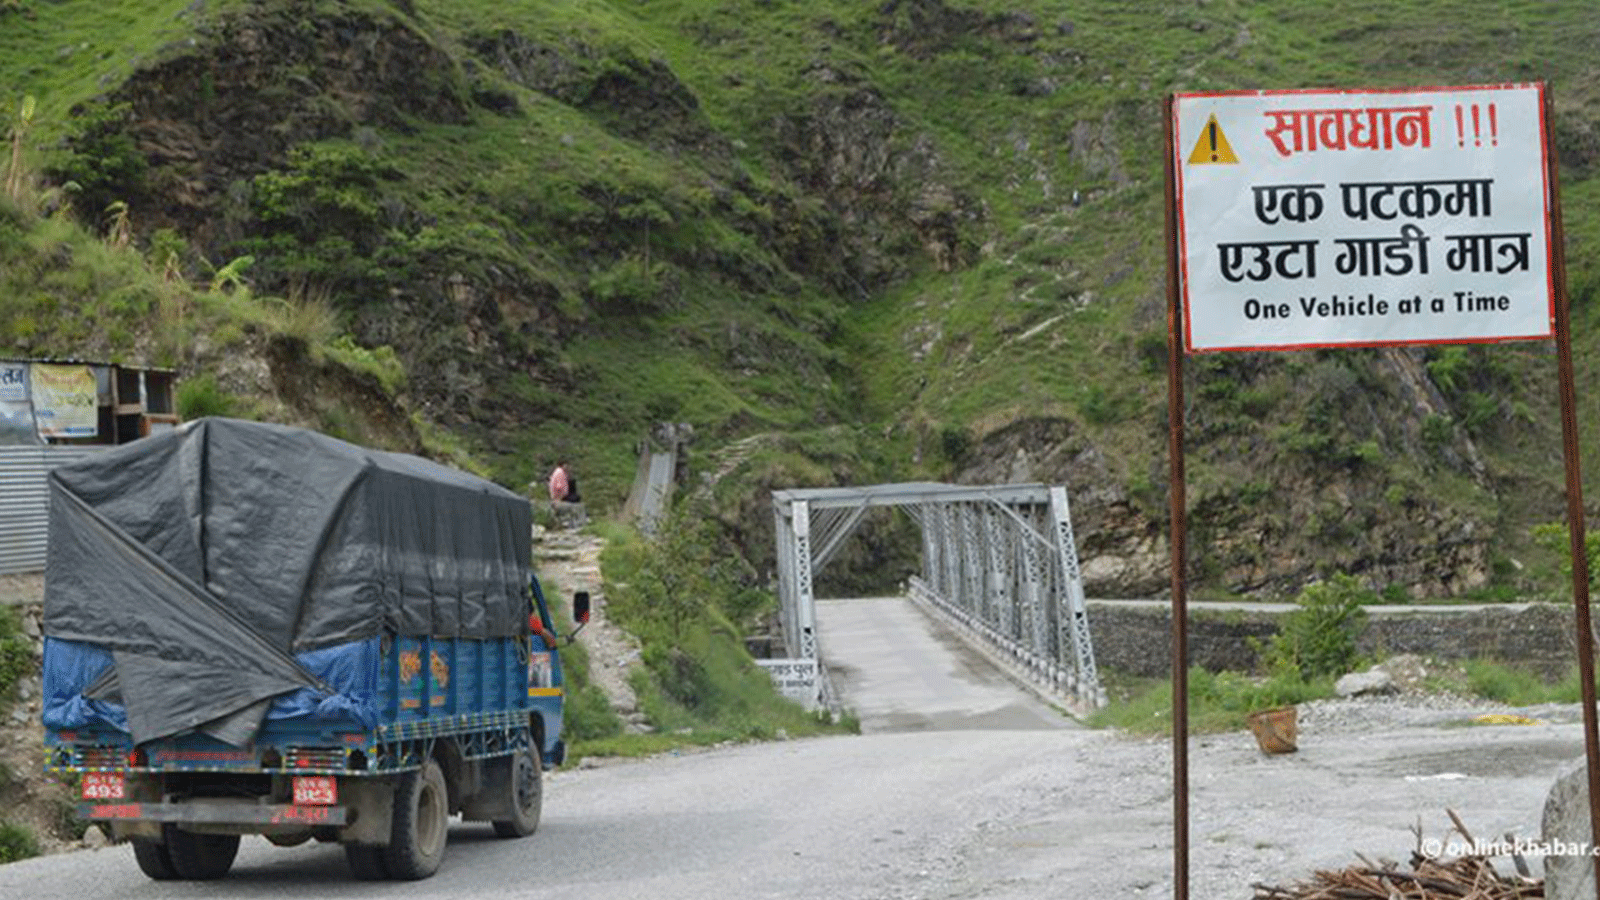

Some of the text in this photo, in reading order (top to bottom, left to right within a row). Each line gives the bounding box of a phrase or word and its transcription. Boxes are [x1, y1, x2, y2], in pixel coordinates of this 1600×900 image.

[1263, 105, 1432, 157] सावधान
[1252, 179, 1493, 225] एक पटकमा
[1217, 223, 1532, 282] एउटा गाडी मात्र
[1244, 291, 1510, 319] One Vehicle at a Time
[85, 785, 124, 798] 493
